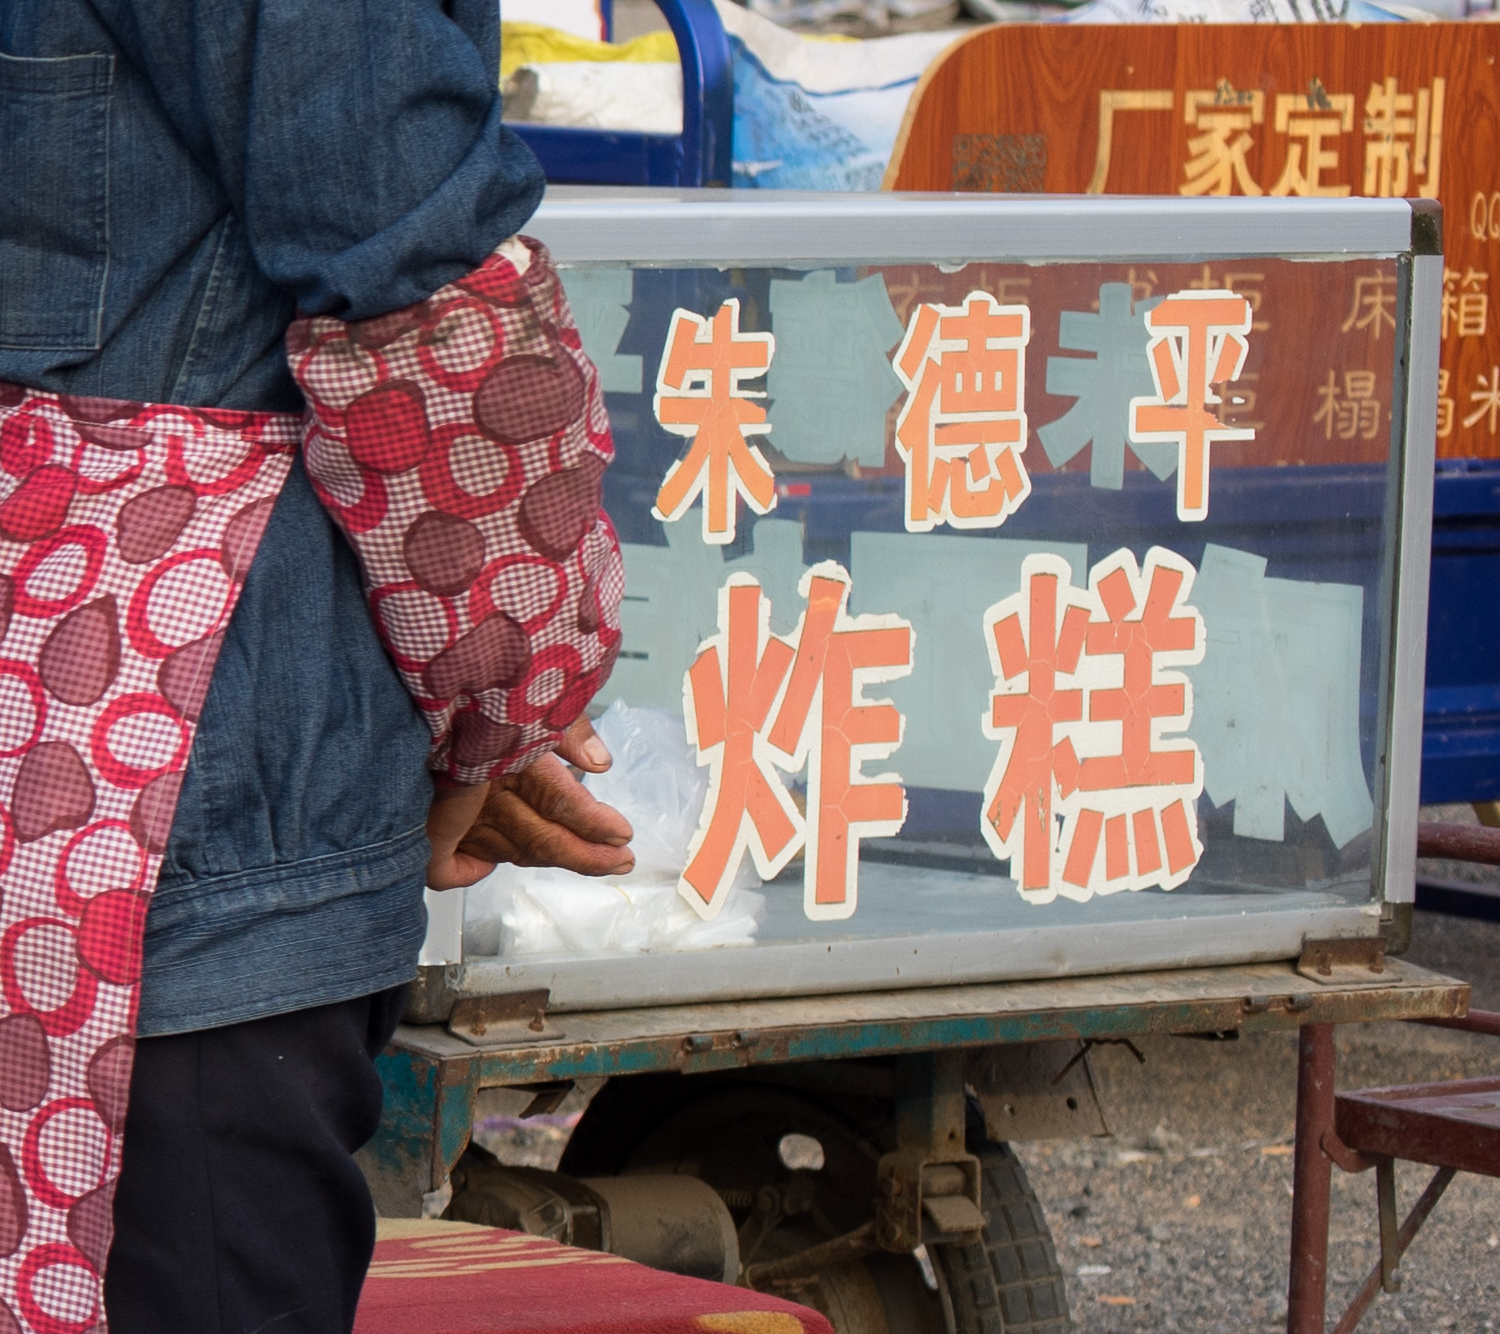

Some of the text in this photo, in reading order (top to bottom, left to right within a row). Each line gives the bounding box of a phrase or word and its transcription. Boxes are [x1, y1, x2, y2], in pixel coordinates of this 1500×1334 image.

[1086, 77, 1446, 197] 厂家定制
[652, 290, 1255, 543] 朱德平
[677, 547, 1206, 921] 炸糕
